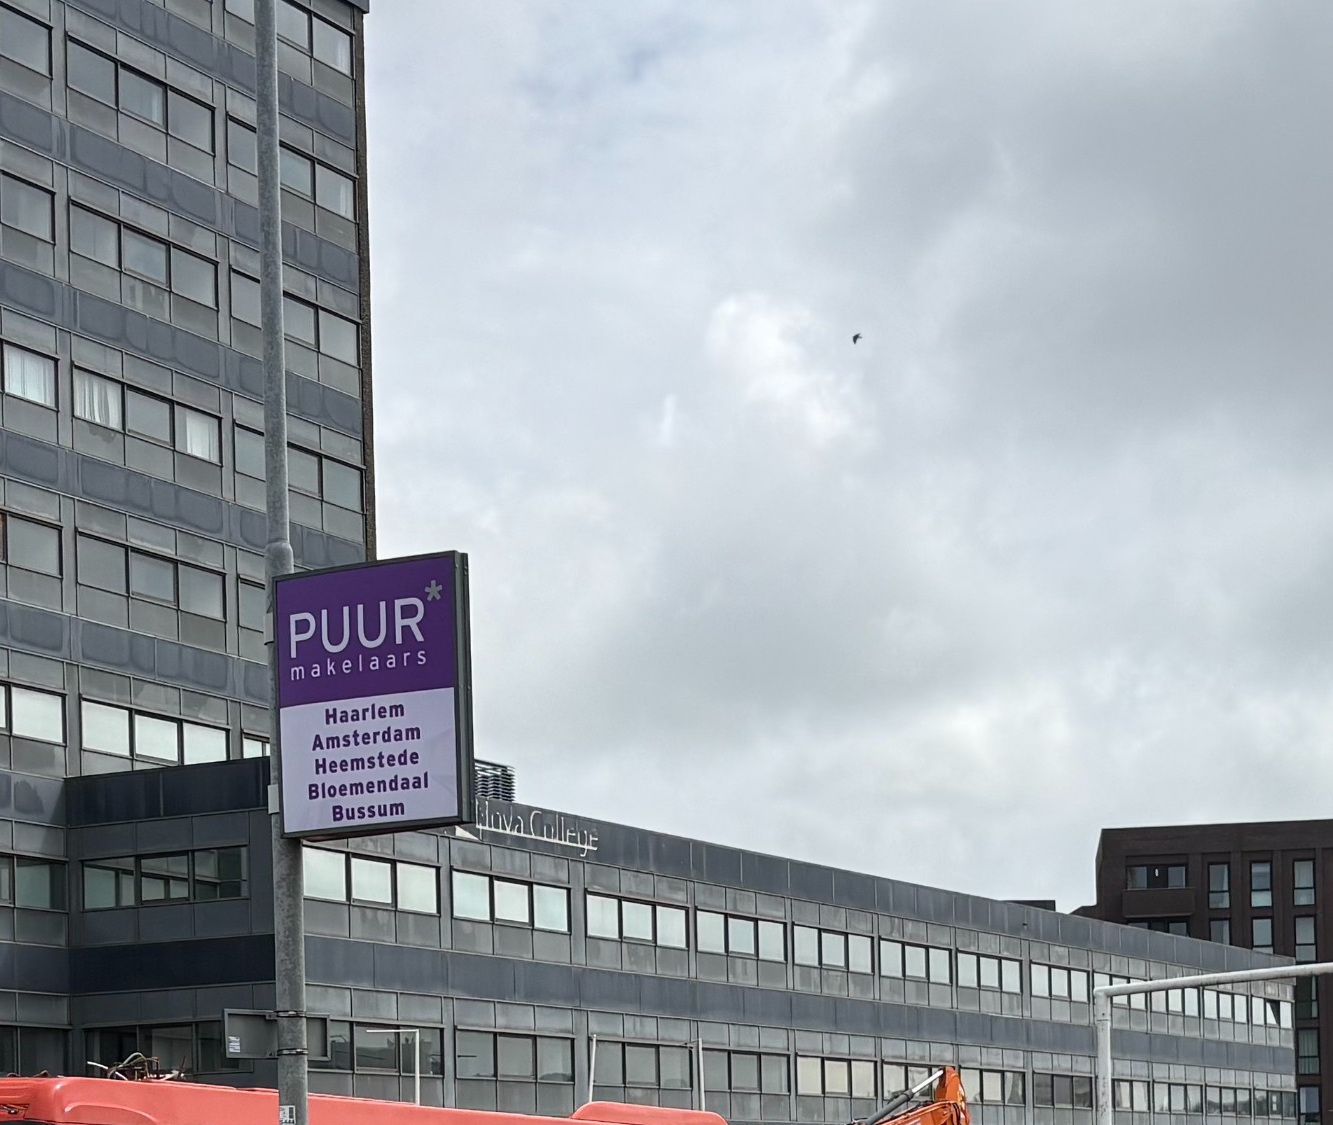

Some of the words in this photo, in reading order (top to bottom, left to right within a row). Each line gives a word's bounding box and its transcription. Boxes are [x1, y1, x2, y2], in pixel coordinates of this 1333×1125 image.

[289, 597, 426, 659] PUUR
[290, 648, 428, 681] makelaars
[324, 702, 405, 725] Haarlem
[311, 726, 422, 752] Amsterdam
[314, 749, 420, 775] Heemstede
[307, 772, 429, 801] Bloemendaal
[331, 800, 406, 822] Bussum
